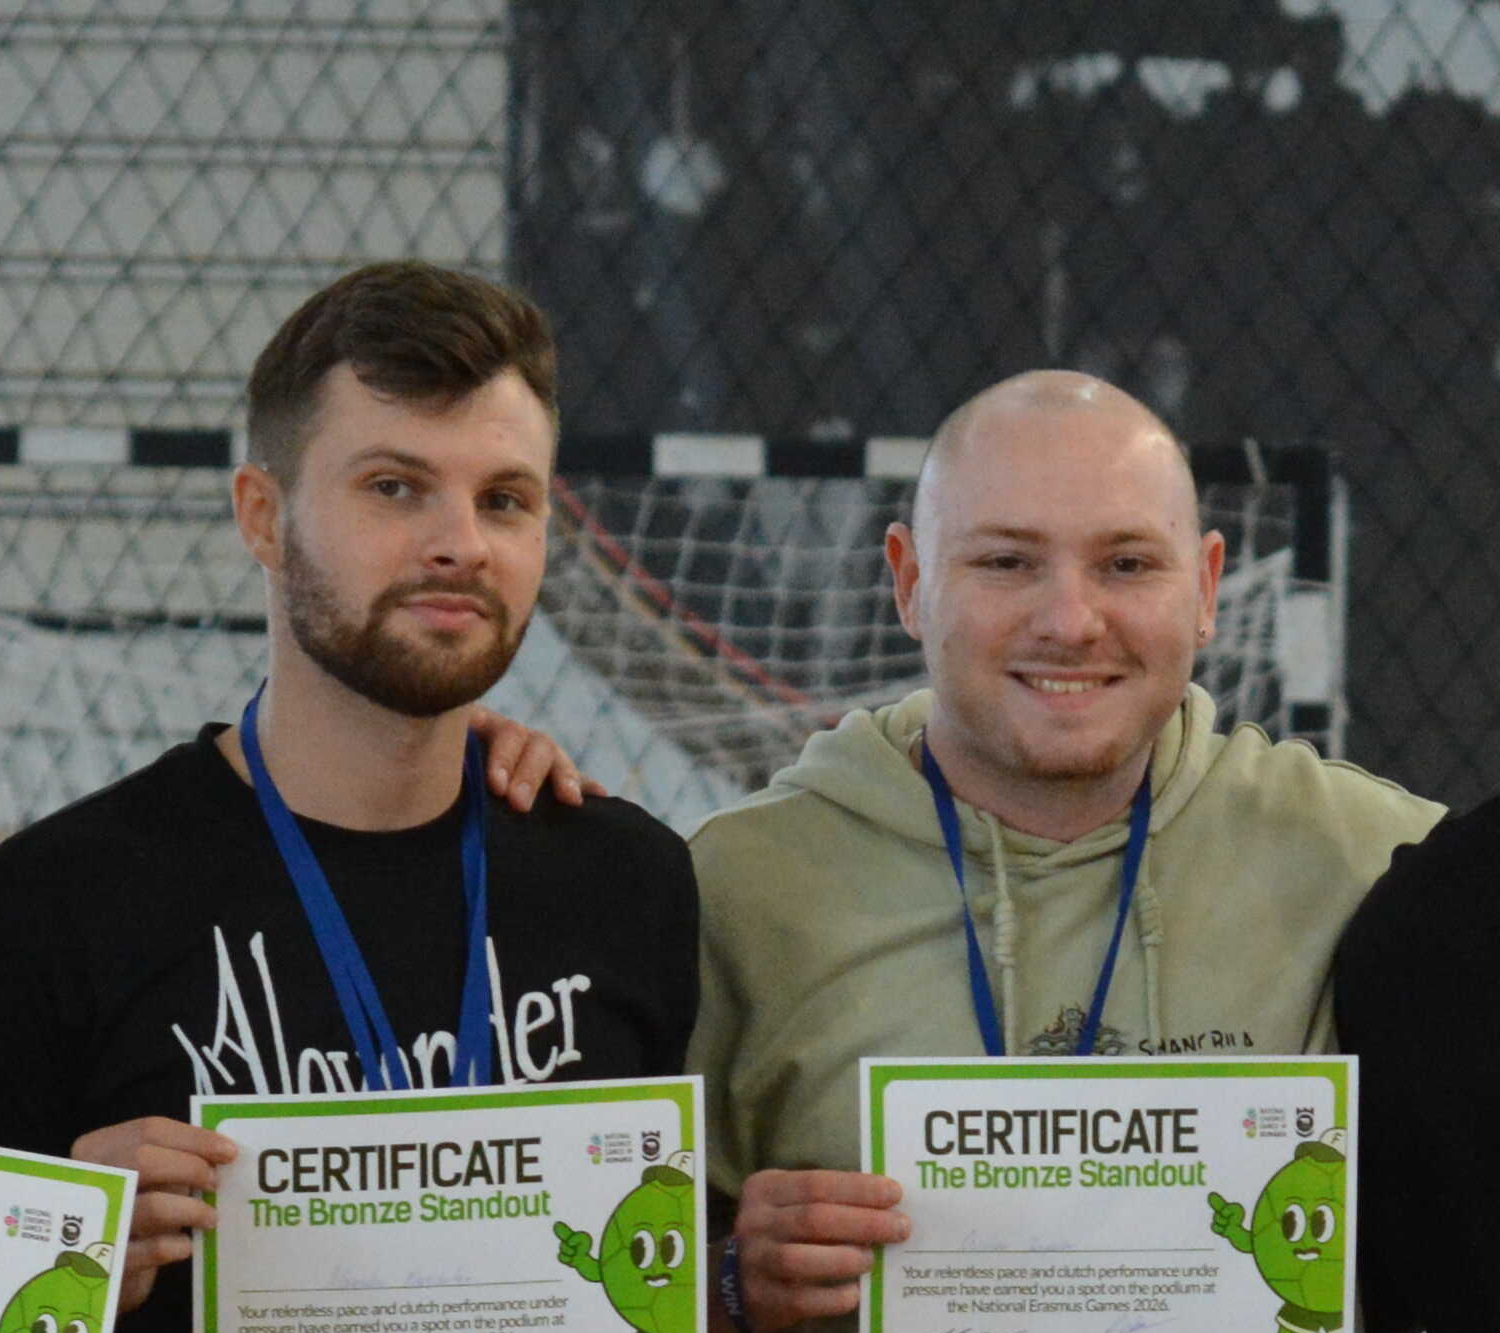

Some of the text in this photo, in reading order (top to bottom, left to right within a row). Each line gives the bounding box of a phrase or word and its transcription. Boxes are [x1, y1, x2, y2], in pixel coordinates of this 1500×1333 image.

[924, 1107, 1198, 1155] CERTIFICATE
[257, 1137, 542, 1193] CERTIFICATE
[915, 1159, 1206, 1189] The Bronze Standout
[248, 1190, 551, 1228] The Bronze Standout
[901, 1263, 1220, 1281] Your relentless pace and clutch performance under
[901, 1279, 1217, 1299] pressure have earned you a spot on the podium at
[237, 1295, 569, 1320] Your relentless pace and clutch performance under
[946, 1299, 970, 1314] the
[970, 1298, 1027, 1313] National
[1027, 1298, 1083, 1313] Erasmus
[1084, 1297, 1131, 1313] Games
[331, 1319, 381, 1333] earned
[409, 1320, 419, 1332] a
[420, 1318, 451, 1333] spot
[451, 1318, 472, 1331] on
[473, 1316, 497, 1330] the
[497, 1313, 550, 1331] podium
[550, 1312, 566, 1327] at
